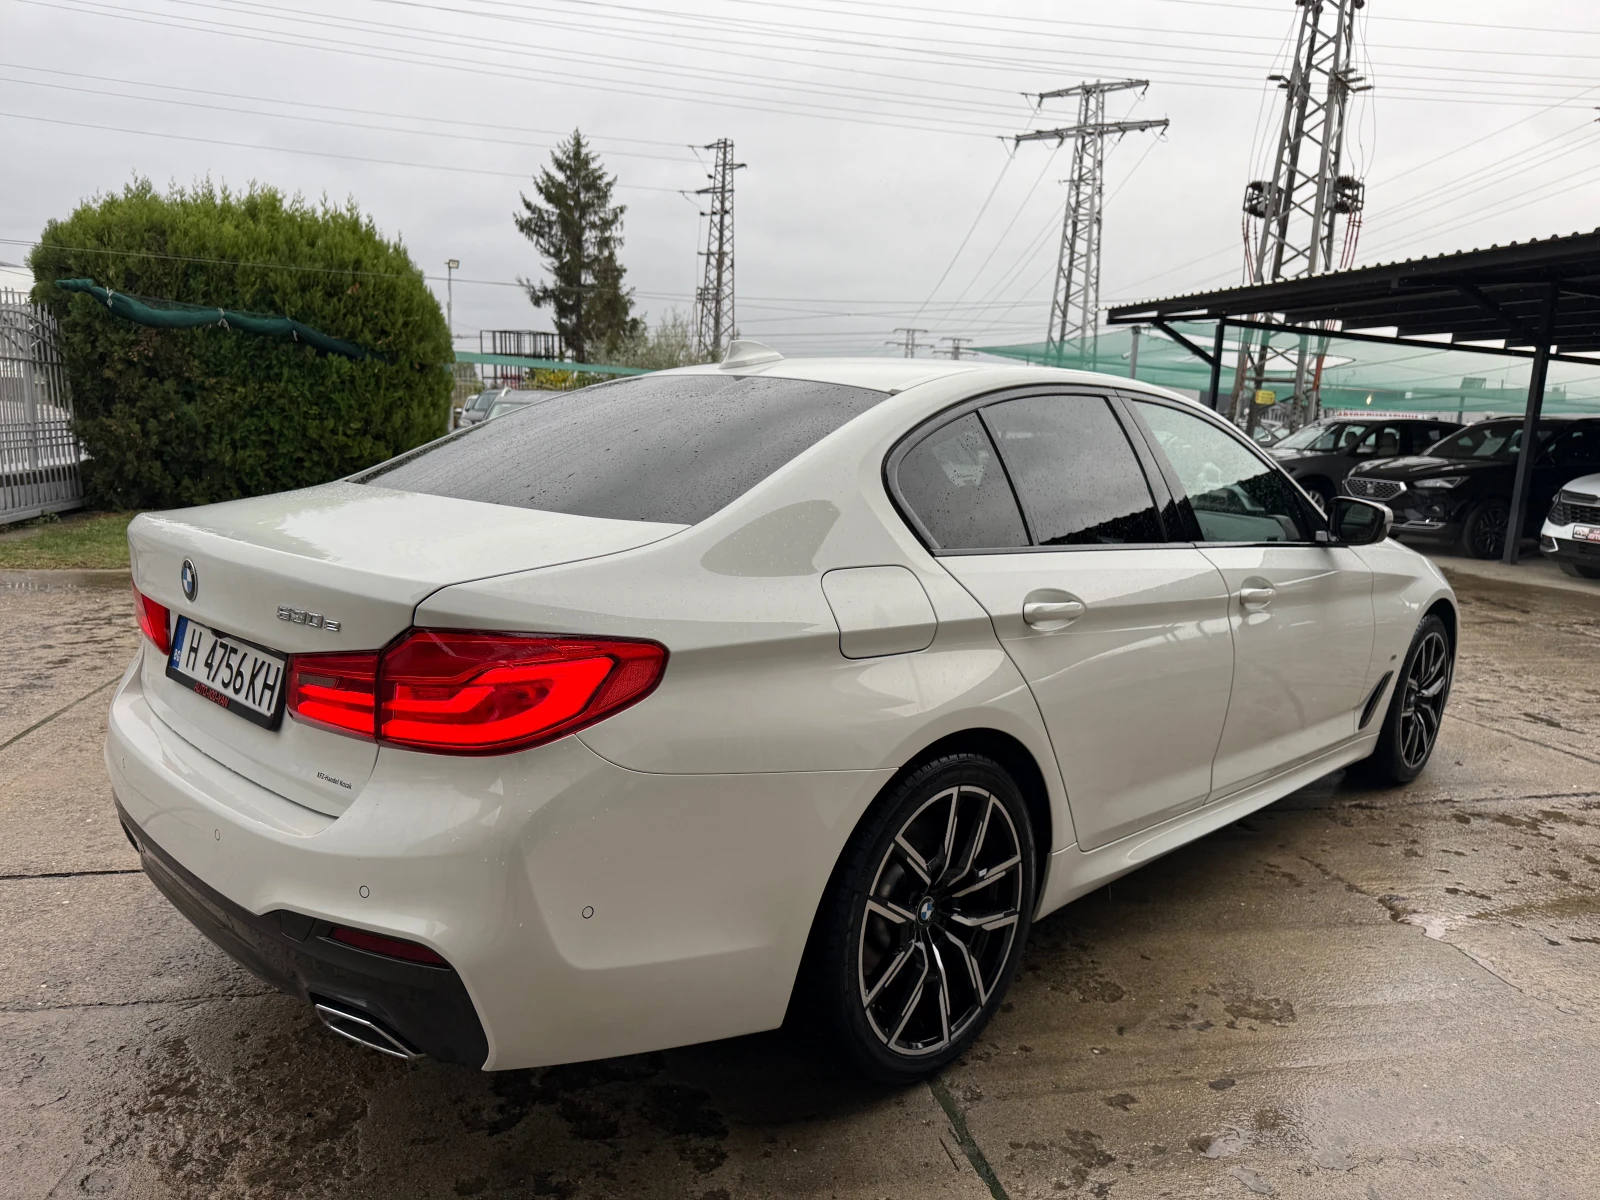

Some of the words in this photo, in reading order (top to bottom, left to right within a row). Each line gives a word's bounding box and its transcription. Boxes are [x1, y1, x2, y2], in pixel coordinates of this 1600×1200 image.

[186, 628, 202, 672] H
[204, 638, 248, 695] 4756
[245, 657, 280, 711] KH
